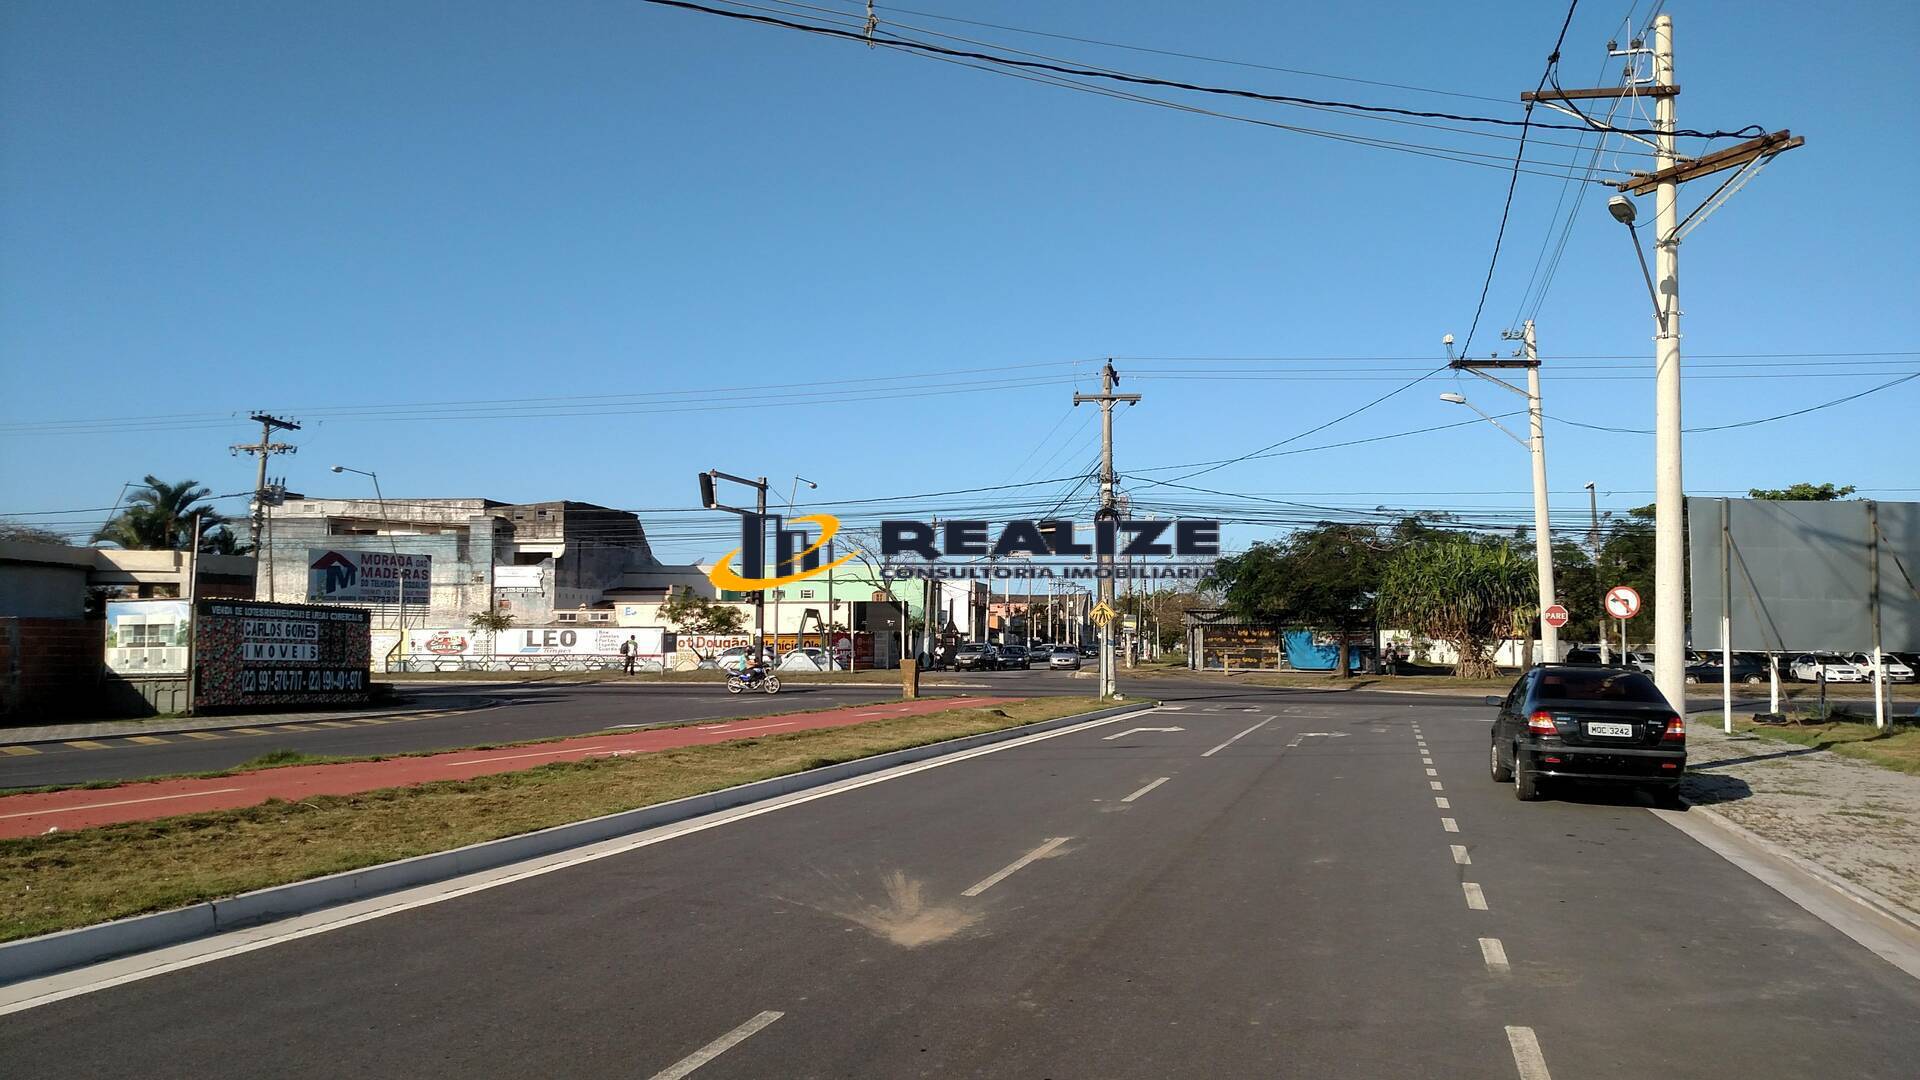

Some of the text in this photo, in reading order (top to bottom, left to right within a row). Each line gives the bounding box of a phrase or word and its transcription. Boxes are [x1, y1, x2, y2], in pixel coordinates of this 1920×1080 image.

[361, 554, 413, 567] MORADA
[361, 567, 429, 580] MADERAS
[235, 606, 243, 615] DE
[306, 611, 311, 619] E
[1545, 612, 1566, 620] PARE
[244, 622, 316, 638] CARLOS GOMES
[526, 630, 577, 648] LEO
[678, 636, 748, 648] ot Dougão
[245, 645, 316, 659] IMOVEIS
